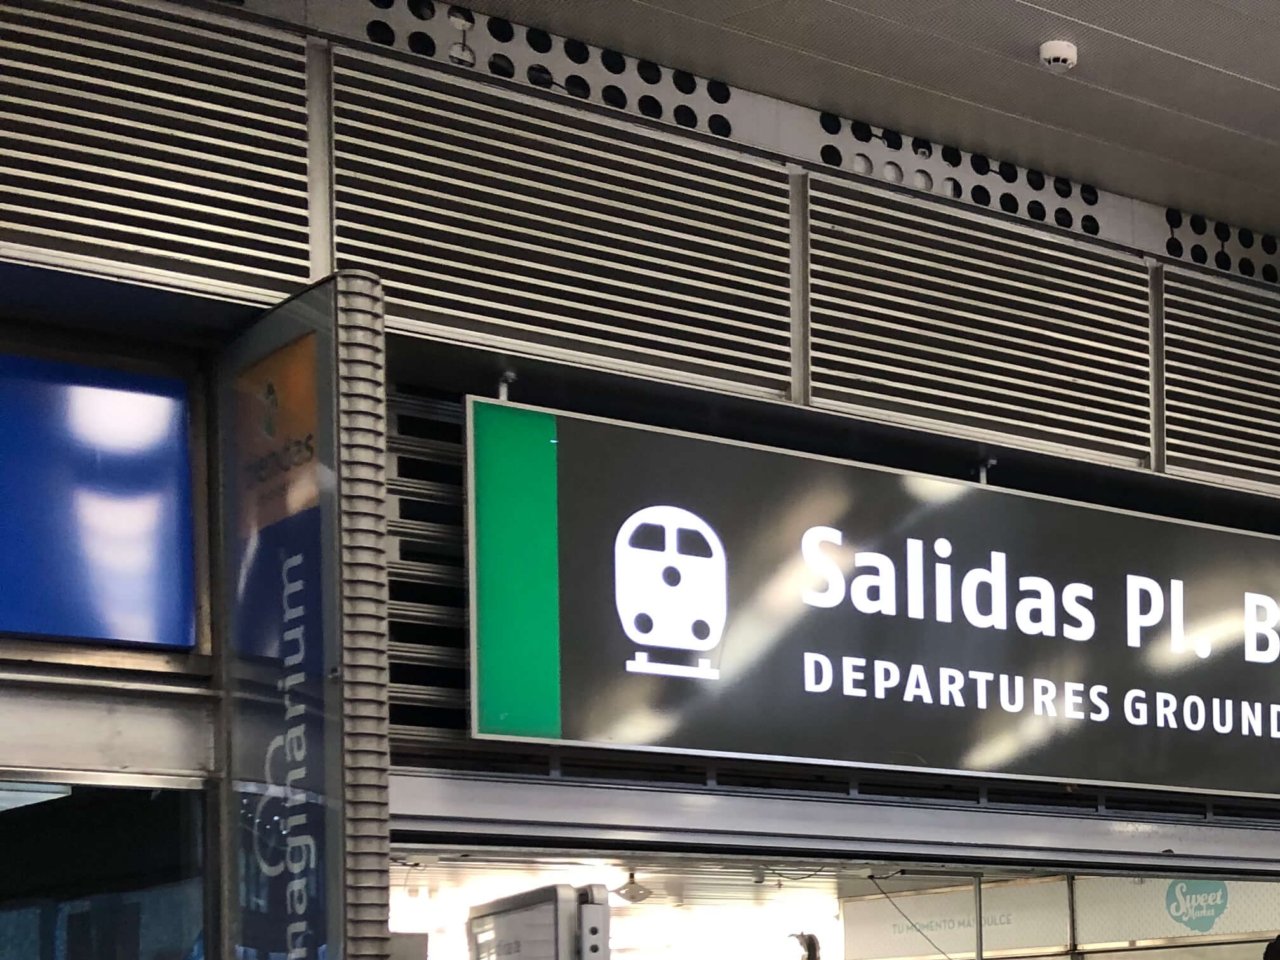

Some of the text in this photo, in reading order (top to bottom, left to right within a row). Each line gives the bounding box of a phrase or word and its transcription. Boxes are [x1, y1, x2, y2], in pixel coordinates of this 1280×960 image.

[800, 526, 1096, 642] Salidas
[1125, 574, 1212, 659] Pl.
[804, 652, 1111, 722] DEPARTURES
[1170, 882, 1223, 917] Sweet
